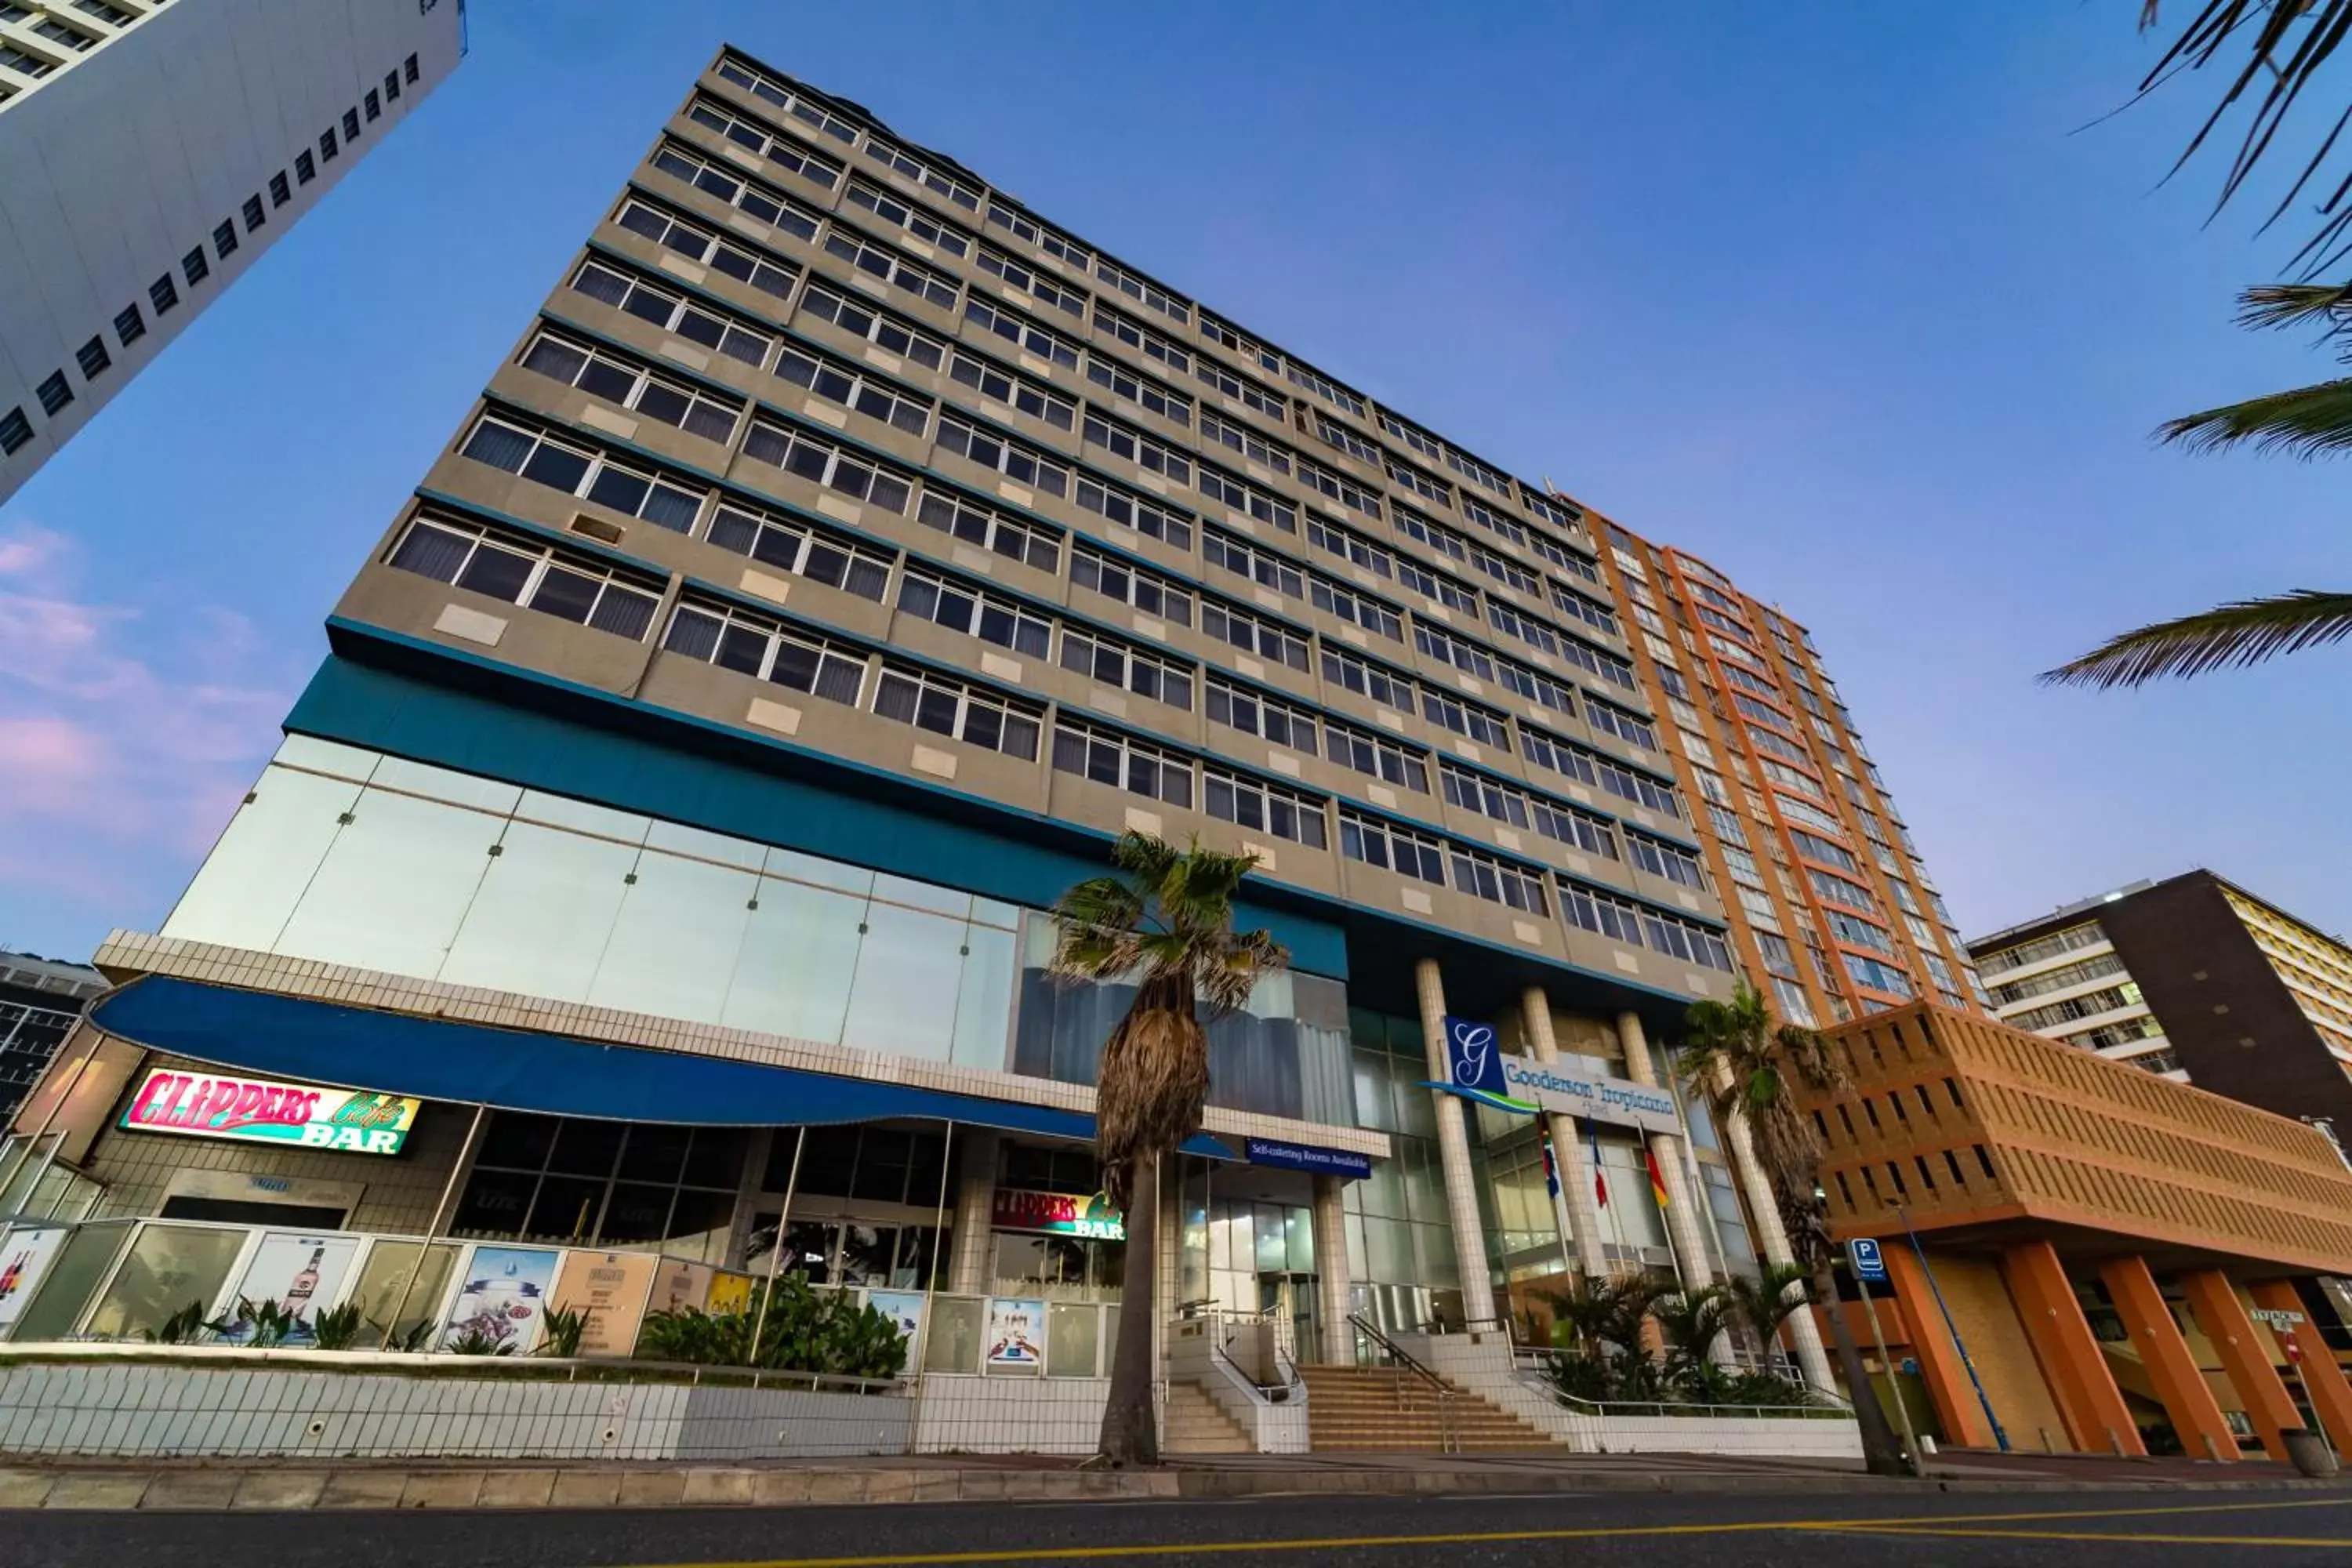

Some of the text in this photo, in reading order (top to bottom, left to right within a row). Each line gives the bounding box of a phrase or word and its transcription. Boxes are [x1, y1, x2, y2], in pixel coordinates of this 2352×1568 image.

[1504, 1063, 1594, 1098] Gooderson
[1595, 1079, 1675, 1116] Tropicana
[304, 1123, 398, 1154] BAR
[1332, 1155, 1368, 1169] Available
[1075, 1219, 1126, 1241] BAR
[1860, 1243, 1871, 1257] P
